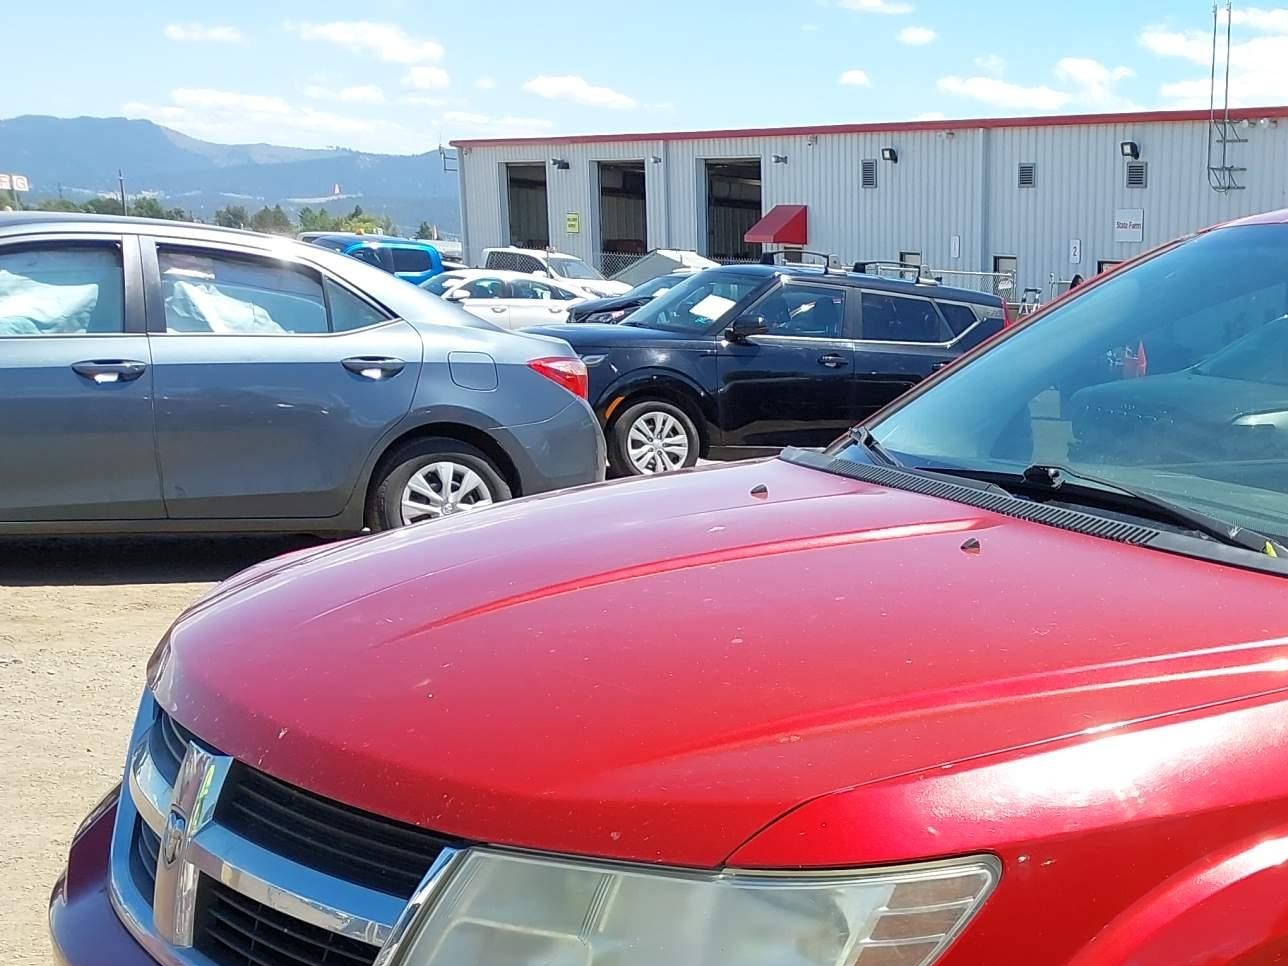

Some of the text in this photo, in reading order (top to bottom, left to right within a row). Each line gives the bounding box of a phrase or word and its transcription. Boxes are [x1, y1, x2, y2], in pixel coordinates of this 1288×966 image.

[1116, 221, 1141, 229] State Farm
[1073, 246, 1078, 257] 2
